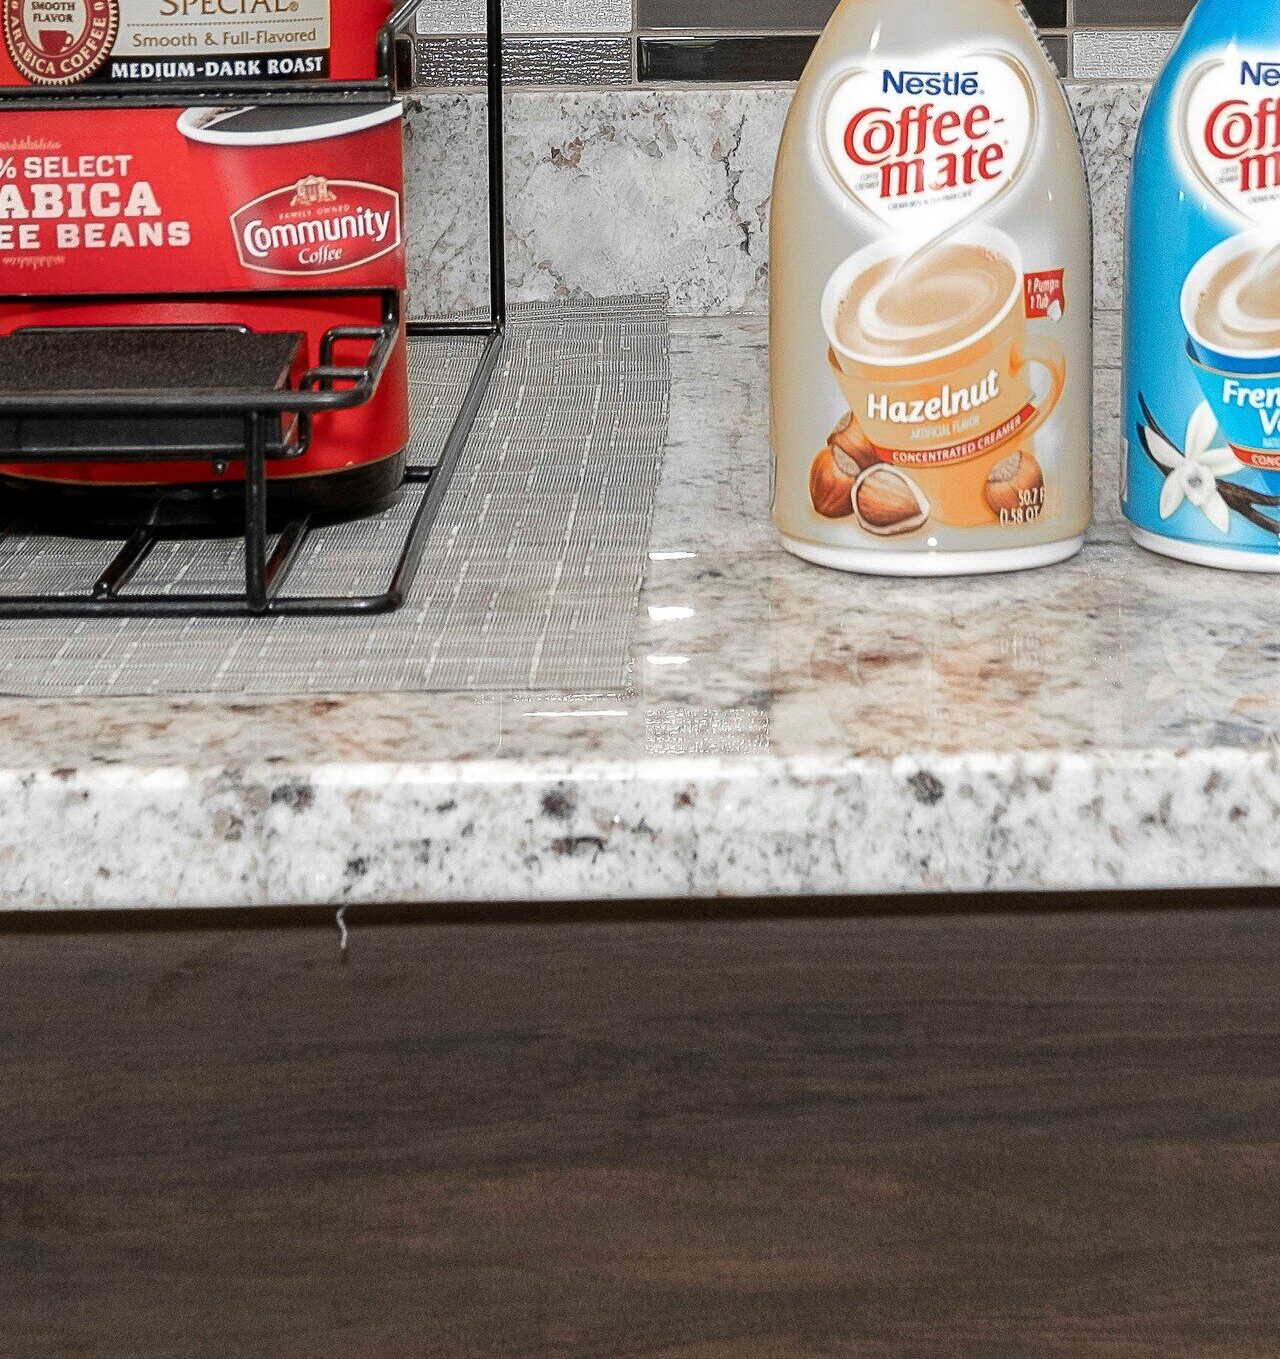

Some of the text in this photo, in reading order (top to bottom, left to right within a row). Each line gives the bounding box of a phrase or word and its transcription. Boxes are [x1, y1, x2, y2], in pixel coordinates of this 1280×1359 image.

[31, 1, 76, 11] SMOOTH
[32, 13, 74, 23] FLAVOR
[10, 15, 107, 75] ARABICA COFFEE
[132, 27, 316, 48] Smooth & Full-Flavored
[111, 56, 324, 79] MEDIUM-DARK ROAST
[23, 154, 133, 179] SELECT
[879, 143, 1004, 198] mate
[56, 220, 191, 250] BEANS
[243, 205, 391, 258] Community
[297, 244, 343, 265] Coffee
[867, 368, 1000, 424] Hazelnut
[892, 414, 1021, 464] CONCENTRATED CREAMER
